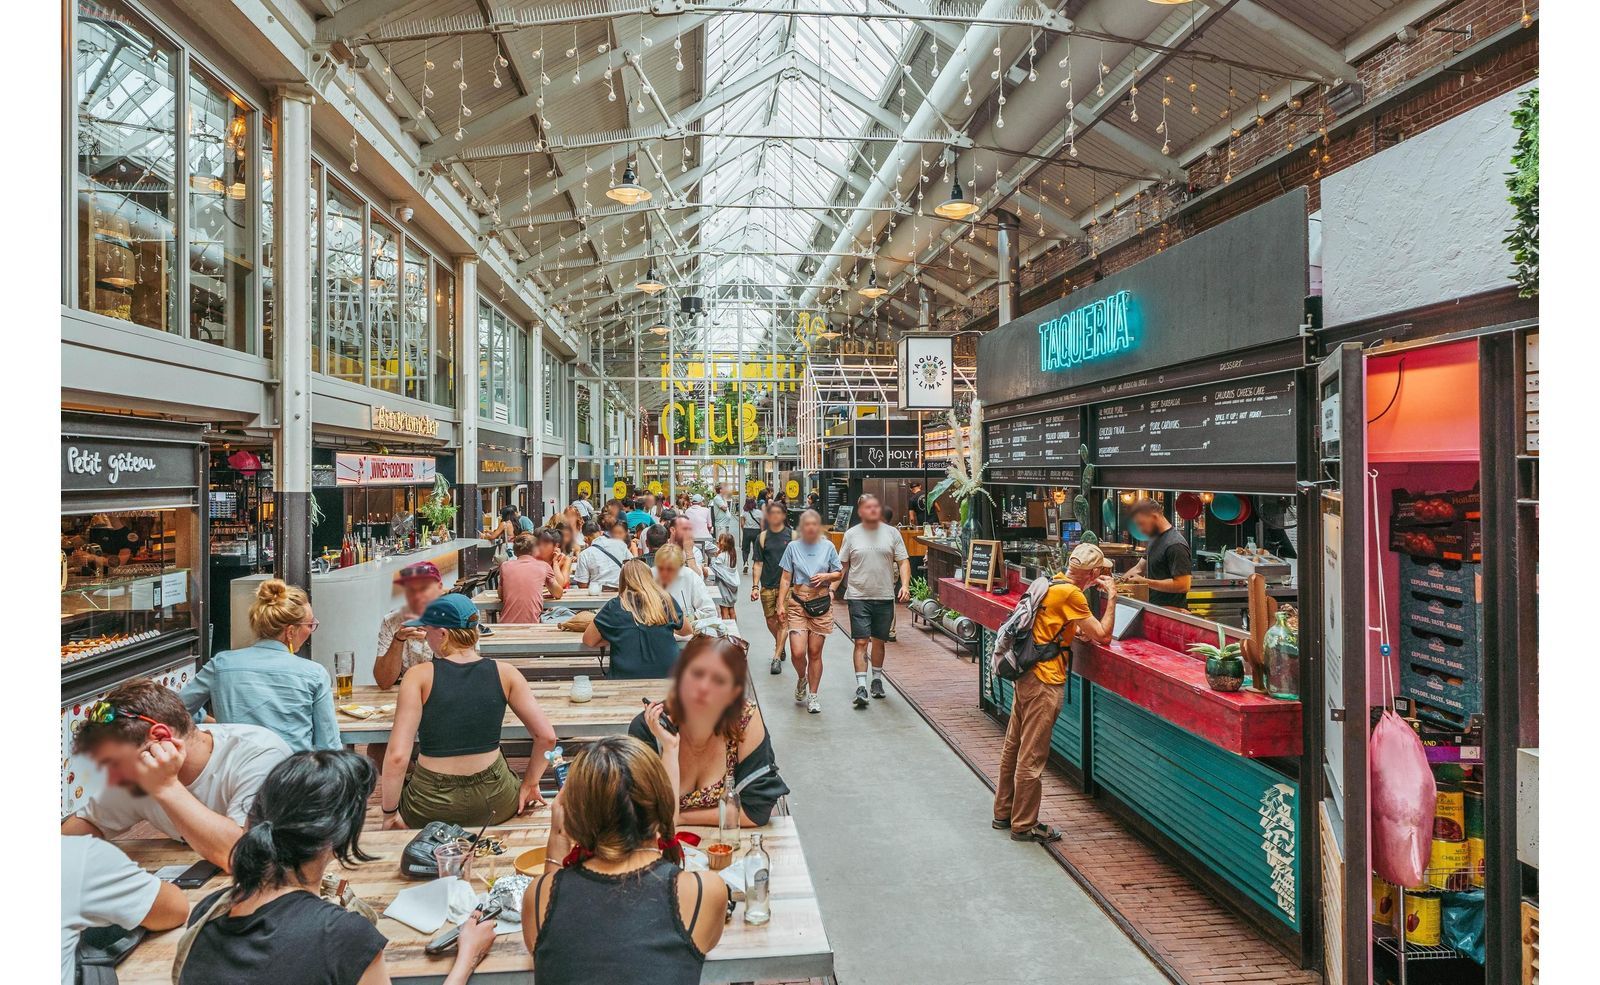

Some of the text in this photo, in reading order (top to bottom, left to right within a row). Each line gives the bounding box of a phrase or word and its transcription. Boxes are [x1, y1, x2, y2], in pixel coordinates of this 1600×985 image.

[1039, 290, 1129, 371] TAQUERIA
[913, 355, 947, 375] TAQUERIA
[919, 381, 941, 390] LIMA
[661, 402, 758, 444] CLUB
[888, 450, 912, 459] HOLY
[67, 446, 156, 484] Petit gâteau
[370, 462, 388, 480] WINES
[390, 462, 414, 479] COCKTAILS
